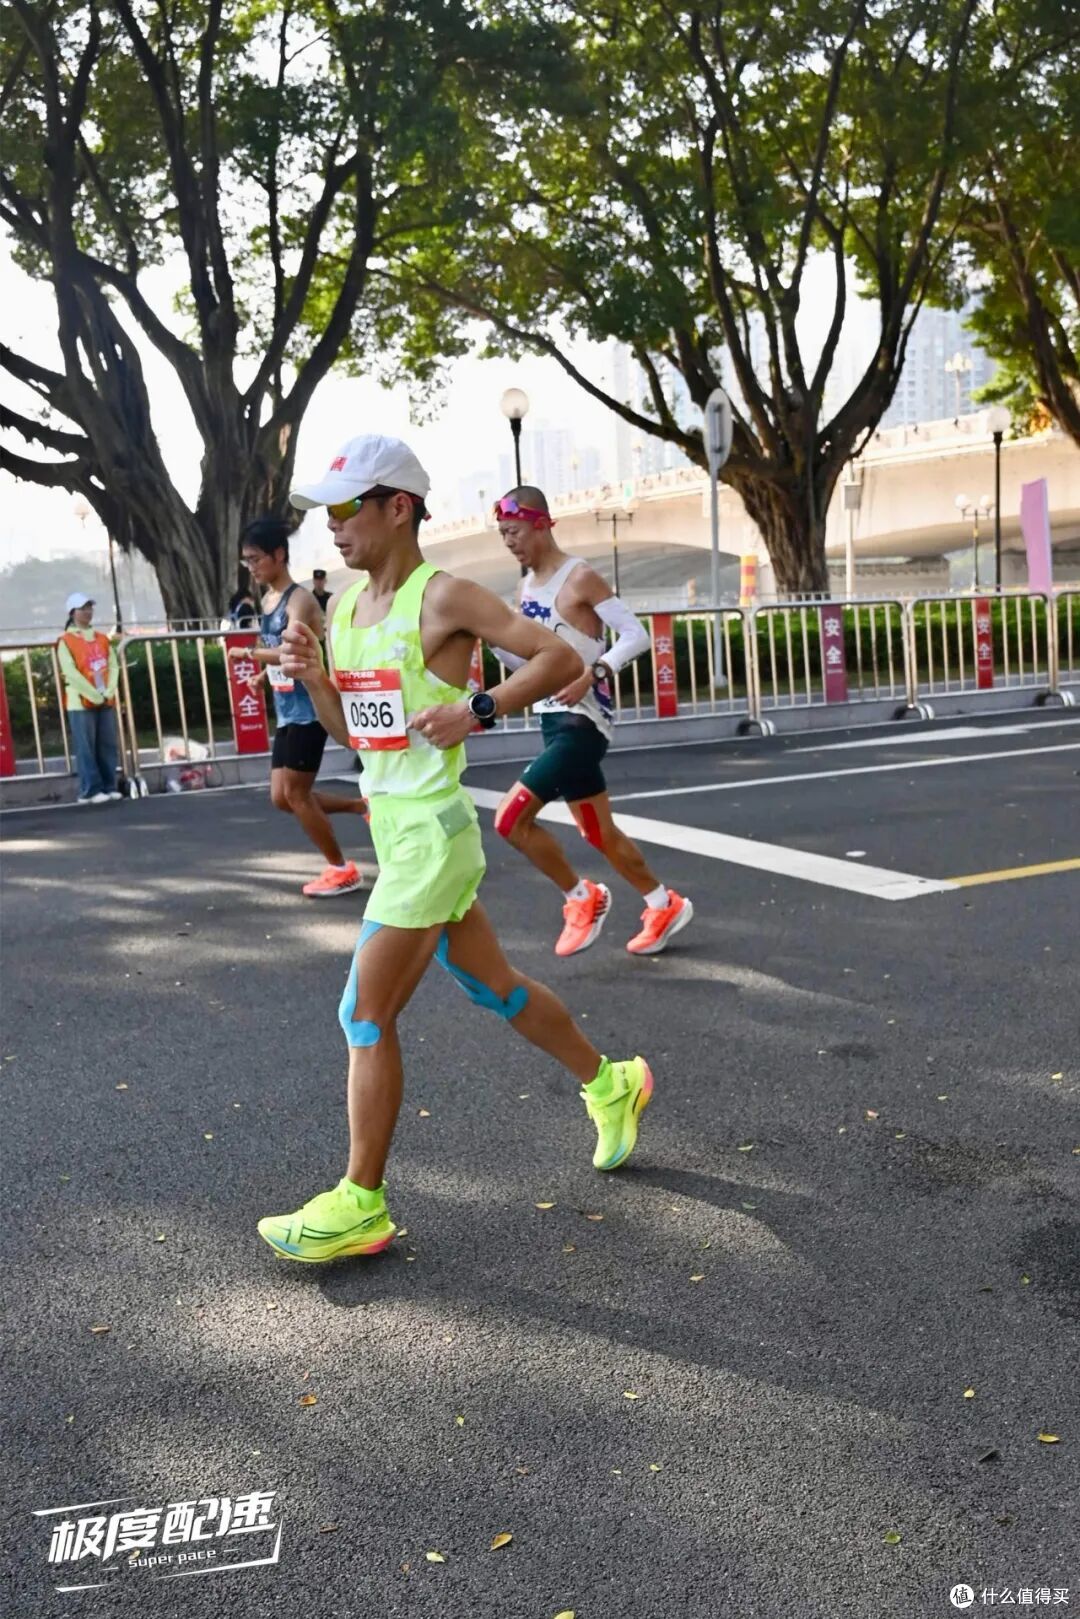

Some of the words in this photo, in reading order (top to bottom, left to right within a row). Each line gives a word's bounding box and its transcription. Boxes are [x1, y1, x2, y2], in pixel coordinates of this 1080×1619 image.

[656, 636, 673, 684] 安全
[824, 617, 842, 665] 安全
[977, 617, 991, 660] 安全
[233, 661, 260, 717] 安全
[350, 701, 394, 728] 0636
